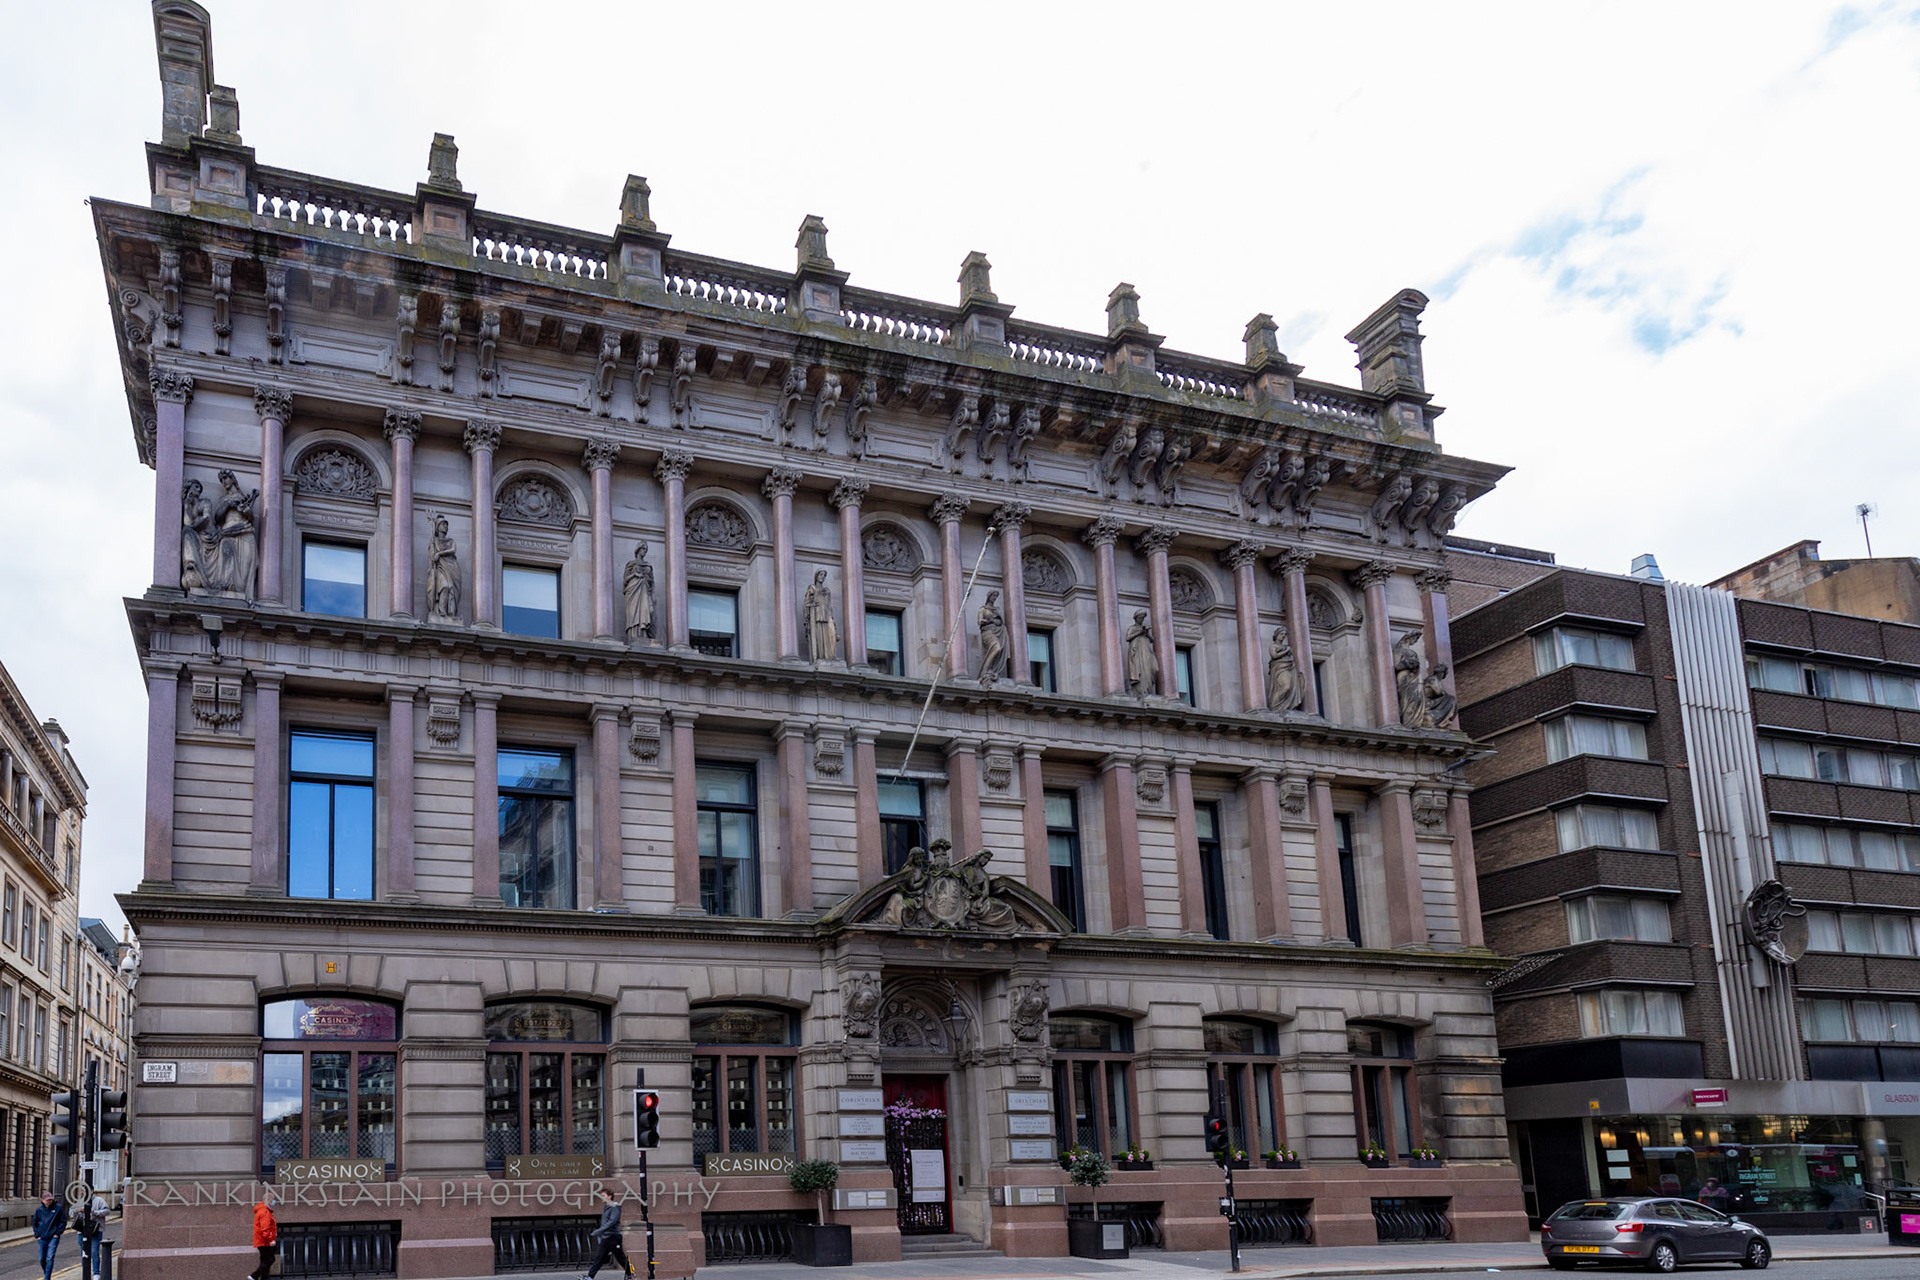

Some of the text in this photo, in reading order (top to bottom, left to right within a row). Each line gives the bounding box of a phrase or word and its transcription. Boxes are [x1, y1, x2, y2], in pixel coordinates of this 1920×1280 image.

[314, 1016, 349, 1024] CASINO
[147, 1064, 173, 1072] INGRAM
[148, 1071, 172, 1079] STREET
[720, 1158, 783, 1172] CASINO
[293, 1164, 369, 1179] CASINO
